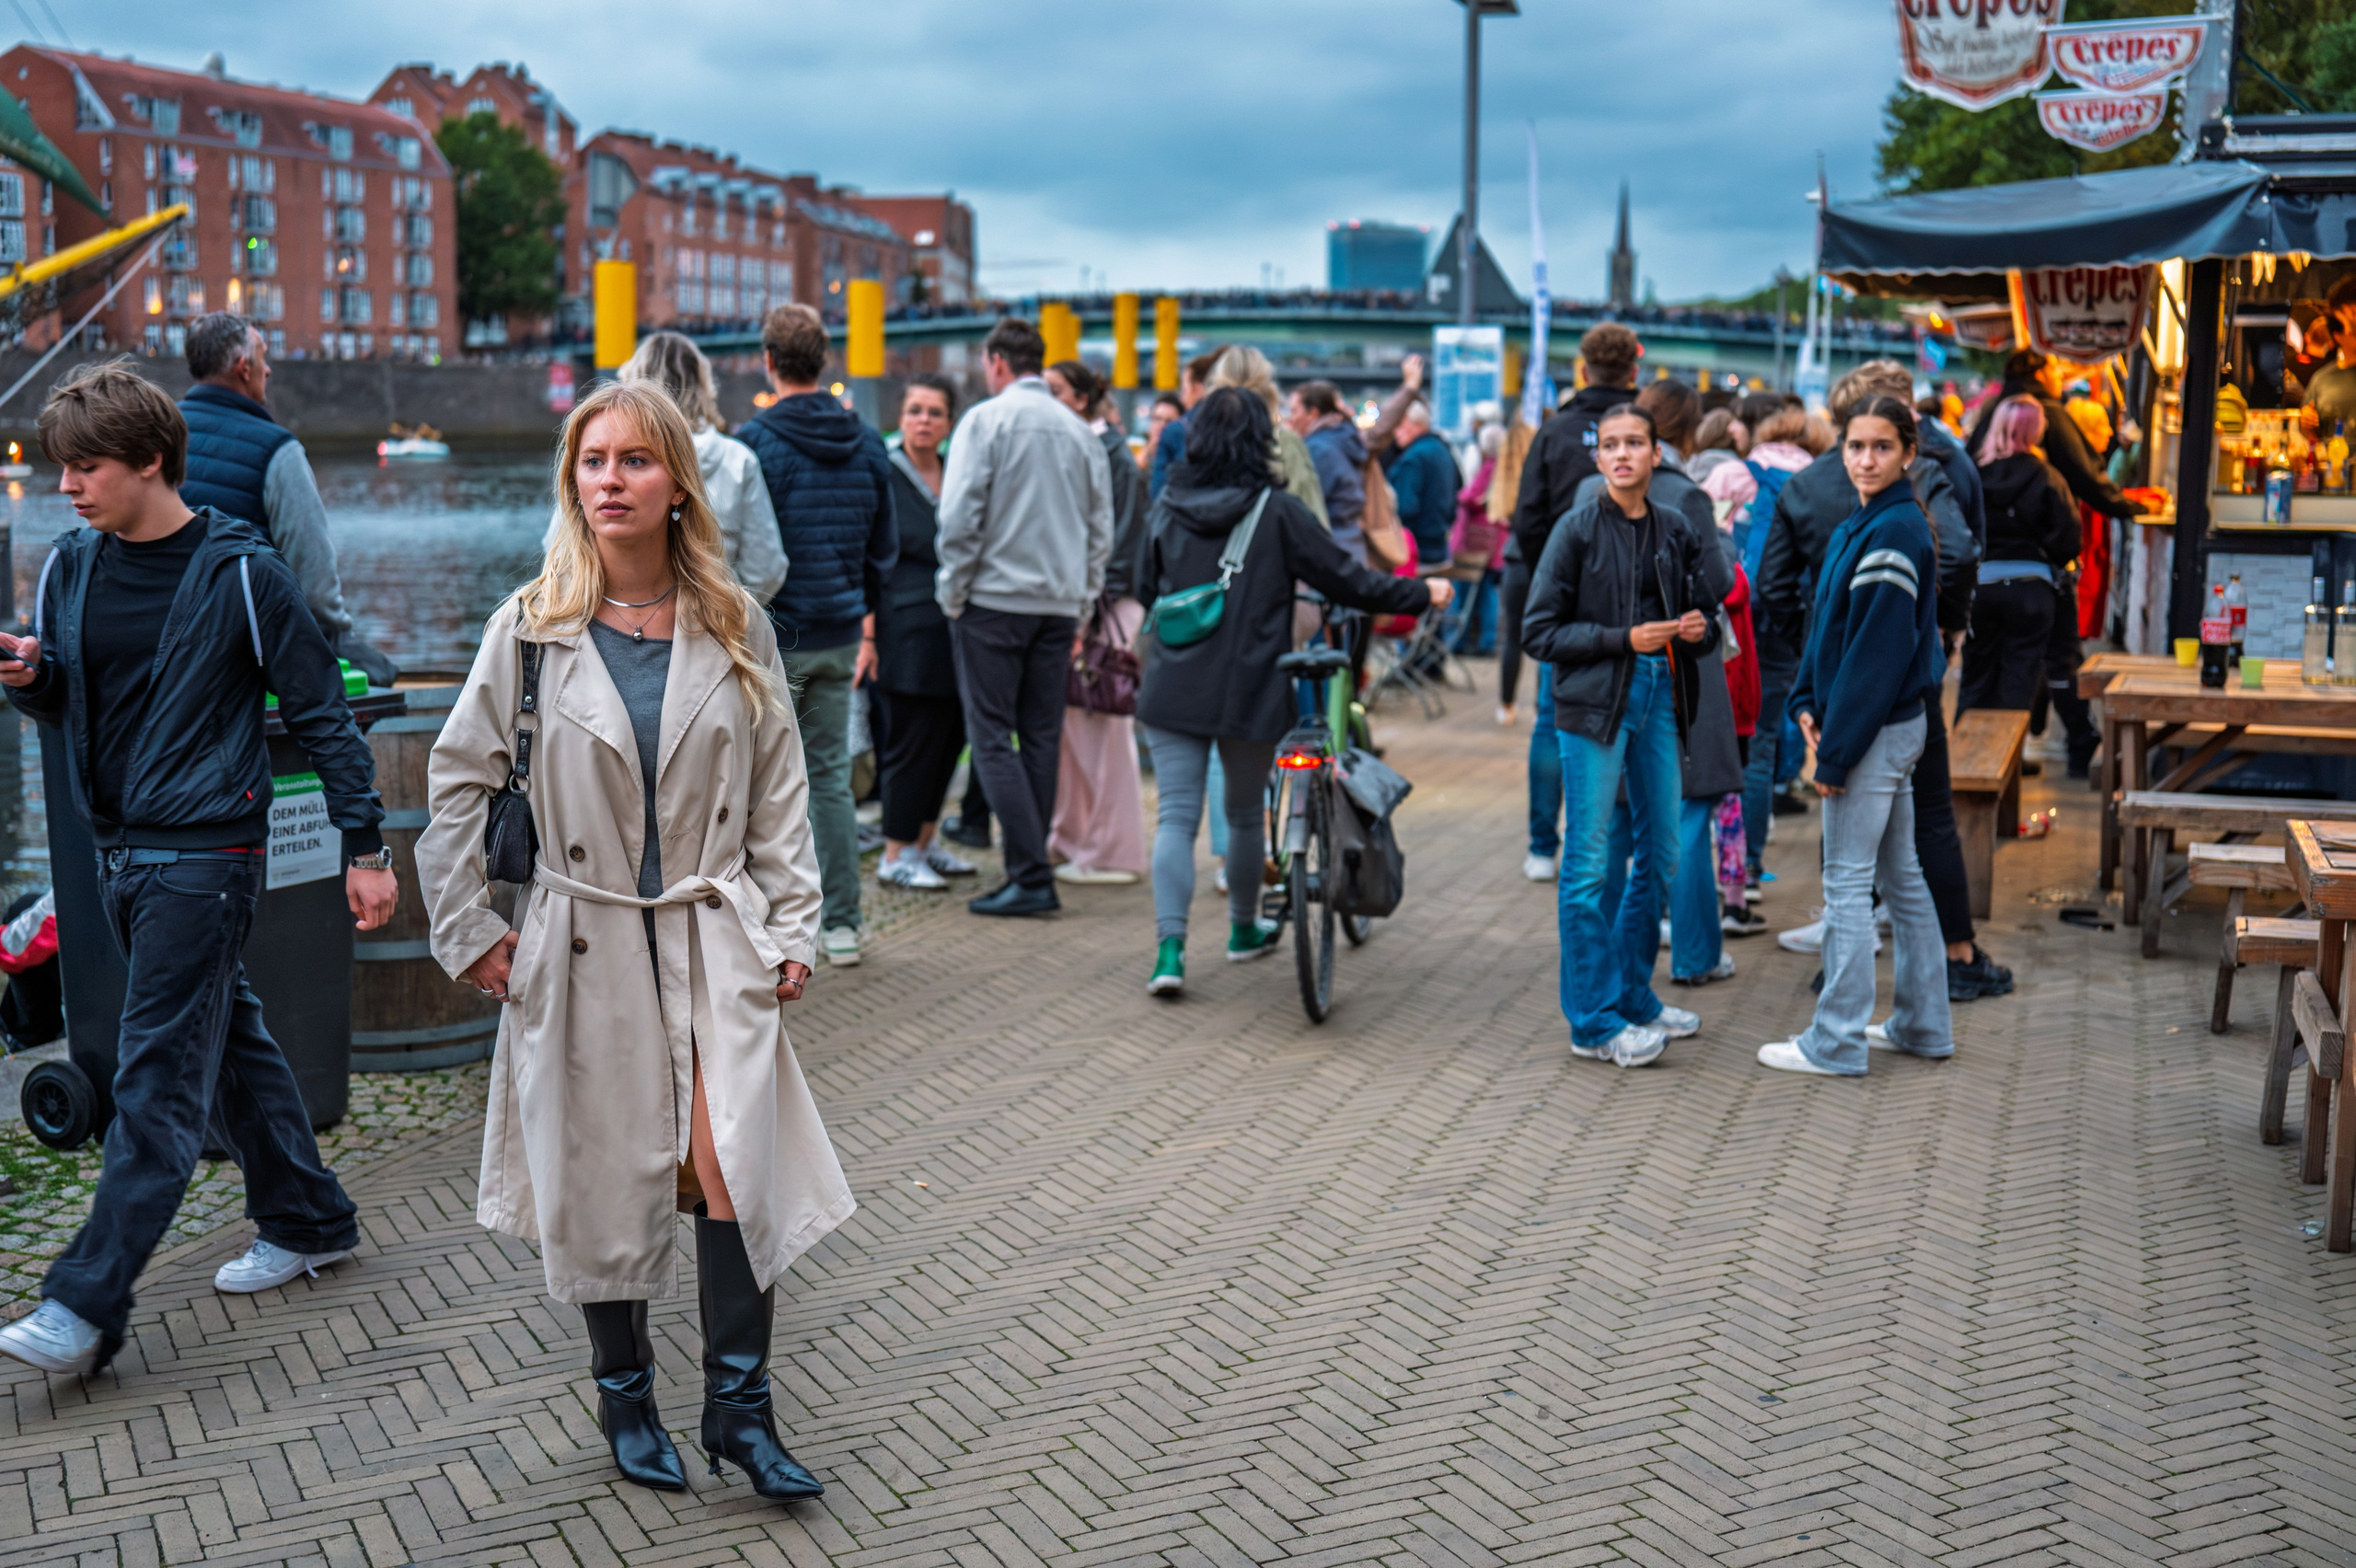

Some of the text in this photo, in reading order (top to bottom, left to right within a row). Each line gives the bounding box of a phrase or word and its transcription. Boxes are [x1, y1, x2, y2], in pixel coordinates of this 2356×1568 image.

[273, 778, 322, 791] Veranstaltung
[272, 800, 325, 821] DEM MÜLL
[272, 818, 332, 838] EINE ABFUH
[272, 836, 323, 857] ERTEILEN.
